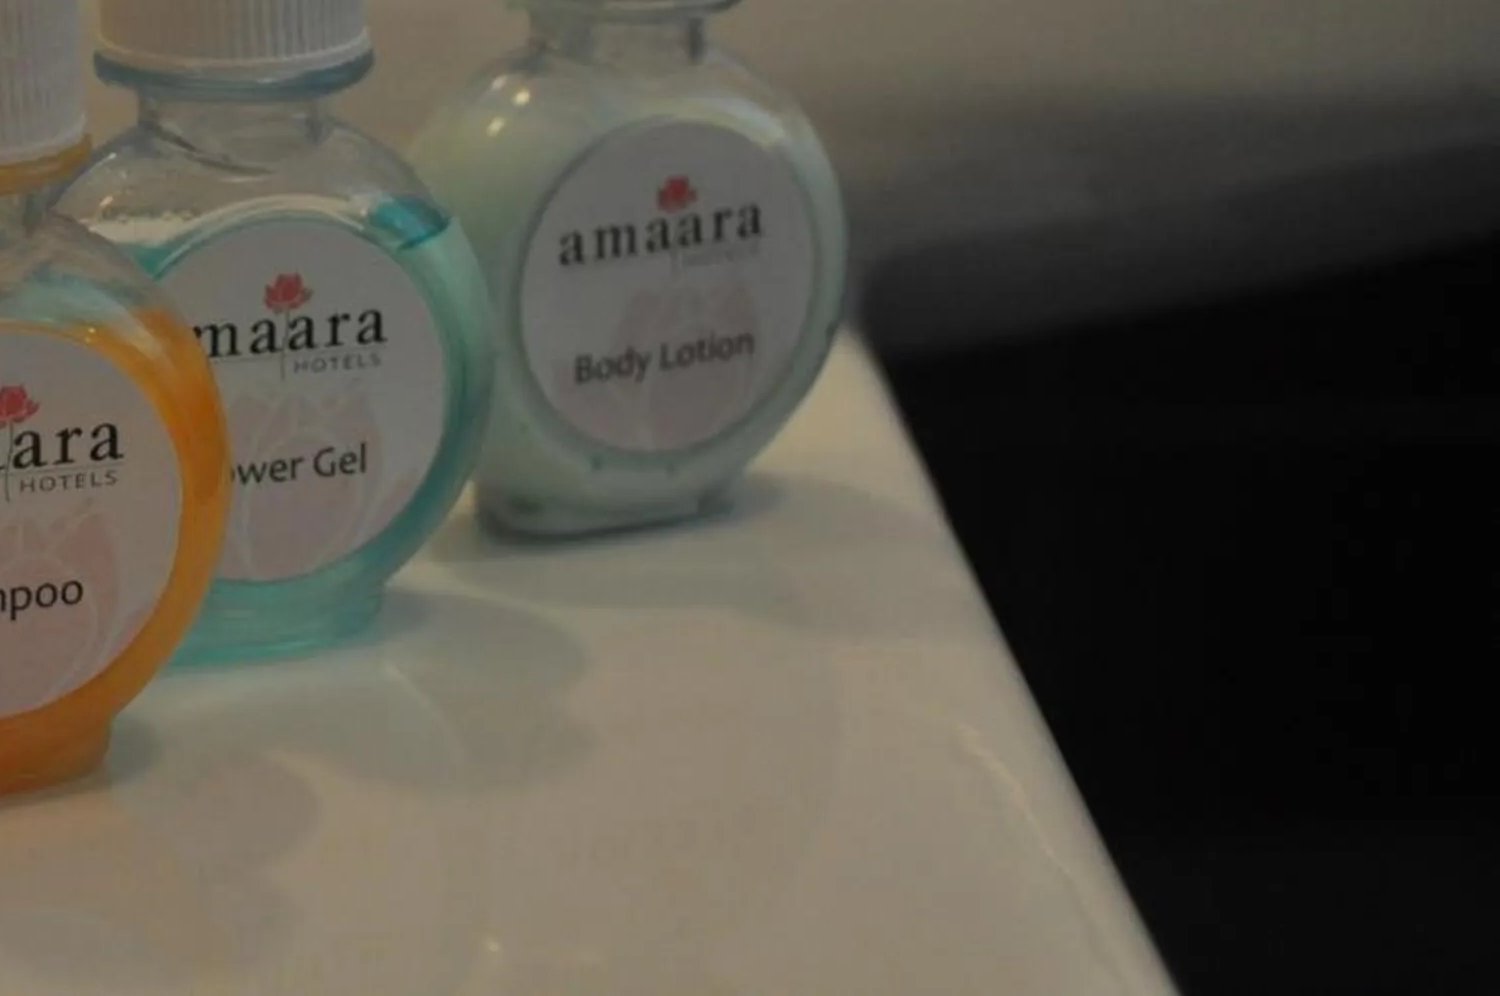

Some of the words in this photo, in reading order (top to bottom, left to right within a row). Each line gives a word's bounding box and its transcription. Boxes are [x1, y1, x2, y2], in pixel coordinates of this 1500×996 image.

[558, 202, 762, 266] amaara
[192, 308, 388, 358] maara
[293, 353, 382, 374] HOTELS
[574, 347, 652, 385] Body
[658, 332, 756, 371] Lotion
[19, 469, 118, 494] HOTELS
[231, 456, 304, 485] wer
[313, 442, 367, 478] Gel
